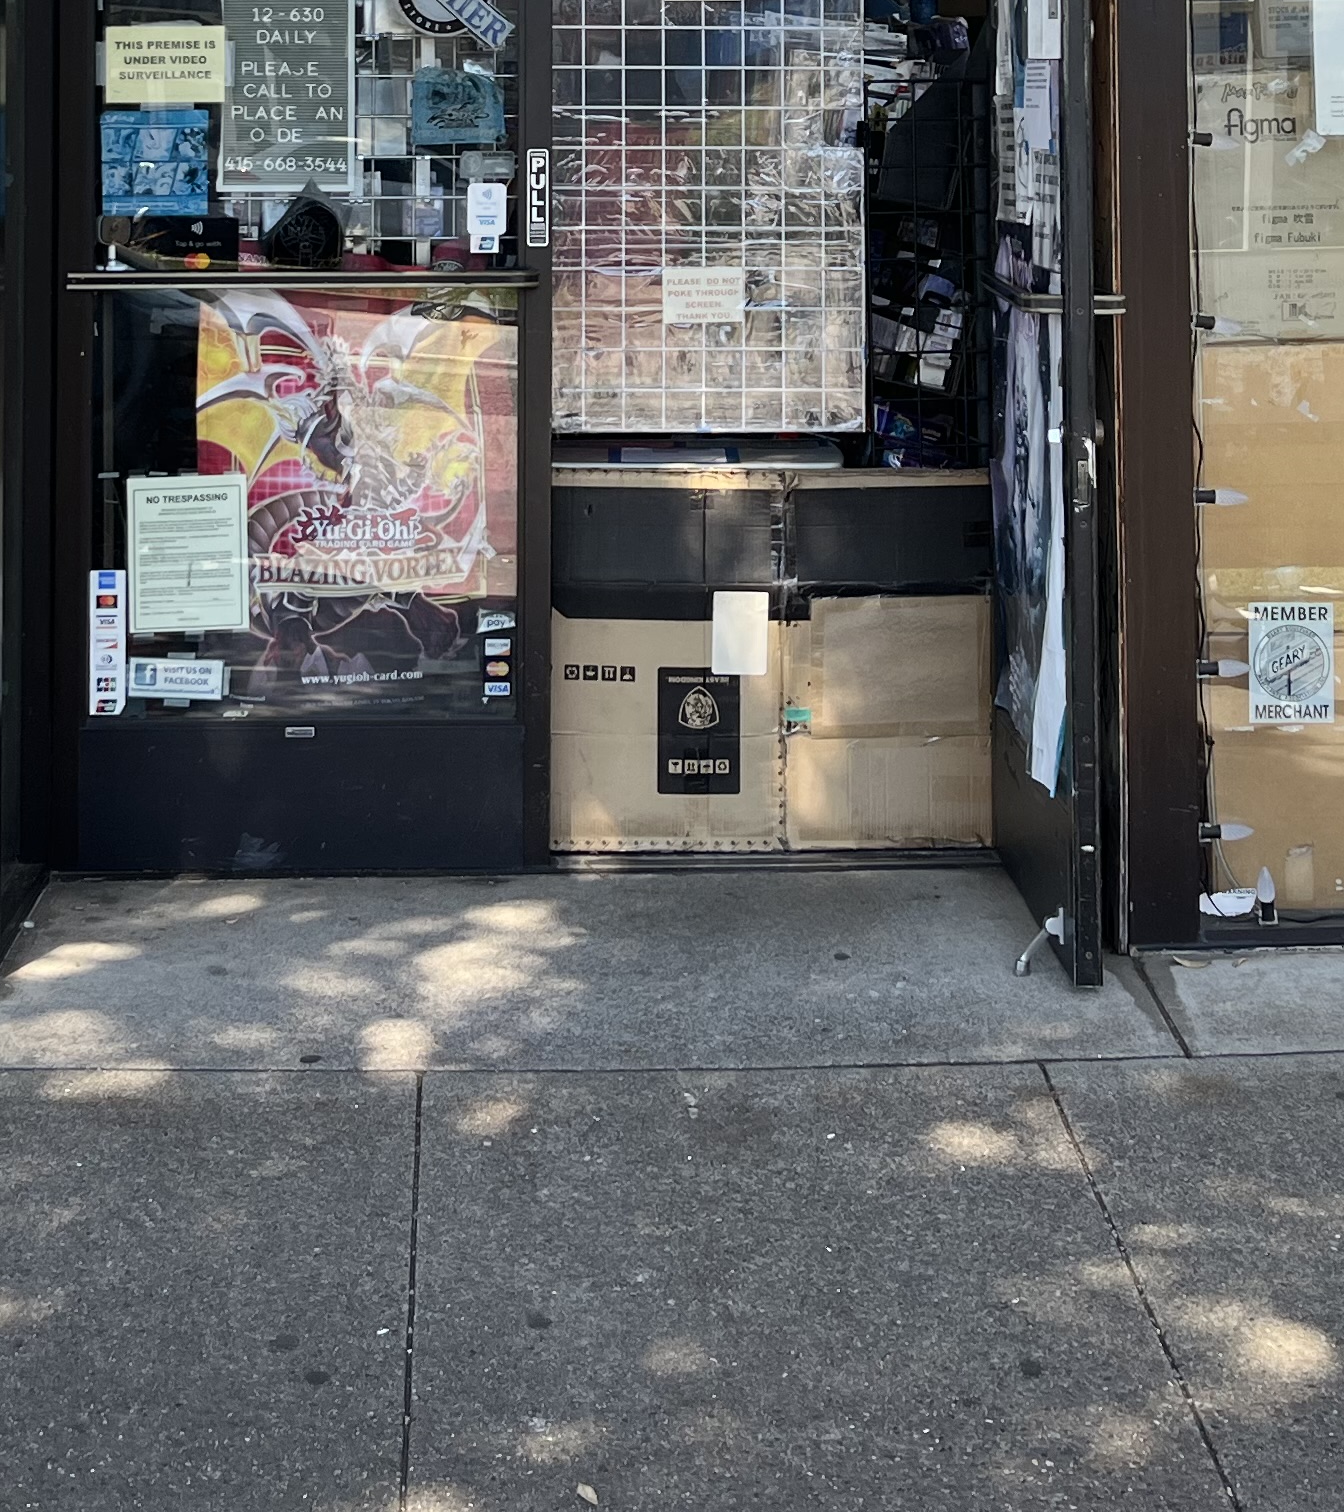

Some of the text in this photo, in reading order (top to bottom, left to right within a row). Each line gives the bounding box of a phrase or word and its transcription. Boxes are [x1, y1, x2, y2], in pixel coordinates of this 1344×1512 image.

[404, 2, 440, 31] STORE
[255, 29, 317, 44] DAILY
[115, 40, 216, 50] THIS PREMISE IS
[123, 55, 207, 65] UNDER VIDEO
[119, 70, 212, 80] SURVEILLANCE
[243, 83, 332, 98] CALL TO
[231, 105, 343, 120] PLACE AN
[1224, 107, 1297, 143] figma
[224, 156, 347, 172] 415-668-3544
[530, 157, 546, 222] PULL
[1287, 231, 1321, 243] Fubuki
[666, 278, 701, 286] PLEASE
[722, 277, 741, 285] NOT
[146, 493, 228, 504] NO TRESPASSING
[313, 518, 415, 541] Yu-Gi-Oh!
[315, 539, 415, 548] TRADING CARD GAME
[258, 549, 465, 585] BLAZING VORTEX
[1254, 606, 1328, 621] MEMBER
[486, 619, 506, 628] pay
[1270, 644, 1306, 674] GEARY
[163, 666, 185, 674] VISIT
[301, 669, 423, 685] www.yugioh-card.com
[163, 677, 209, 686] FACEBOOK
[487, 684, 509, 693] VISA
[1255, 704, 1330, 719] MERCHANT
